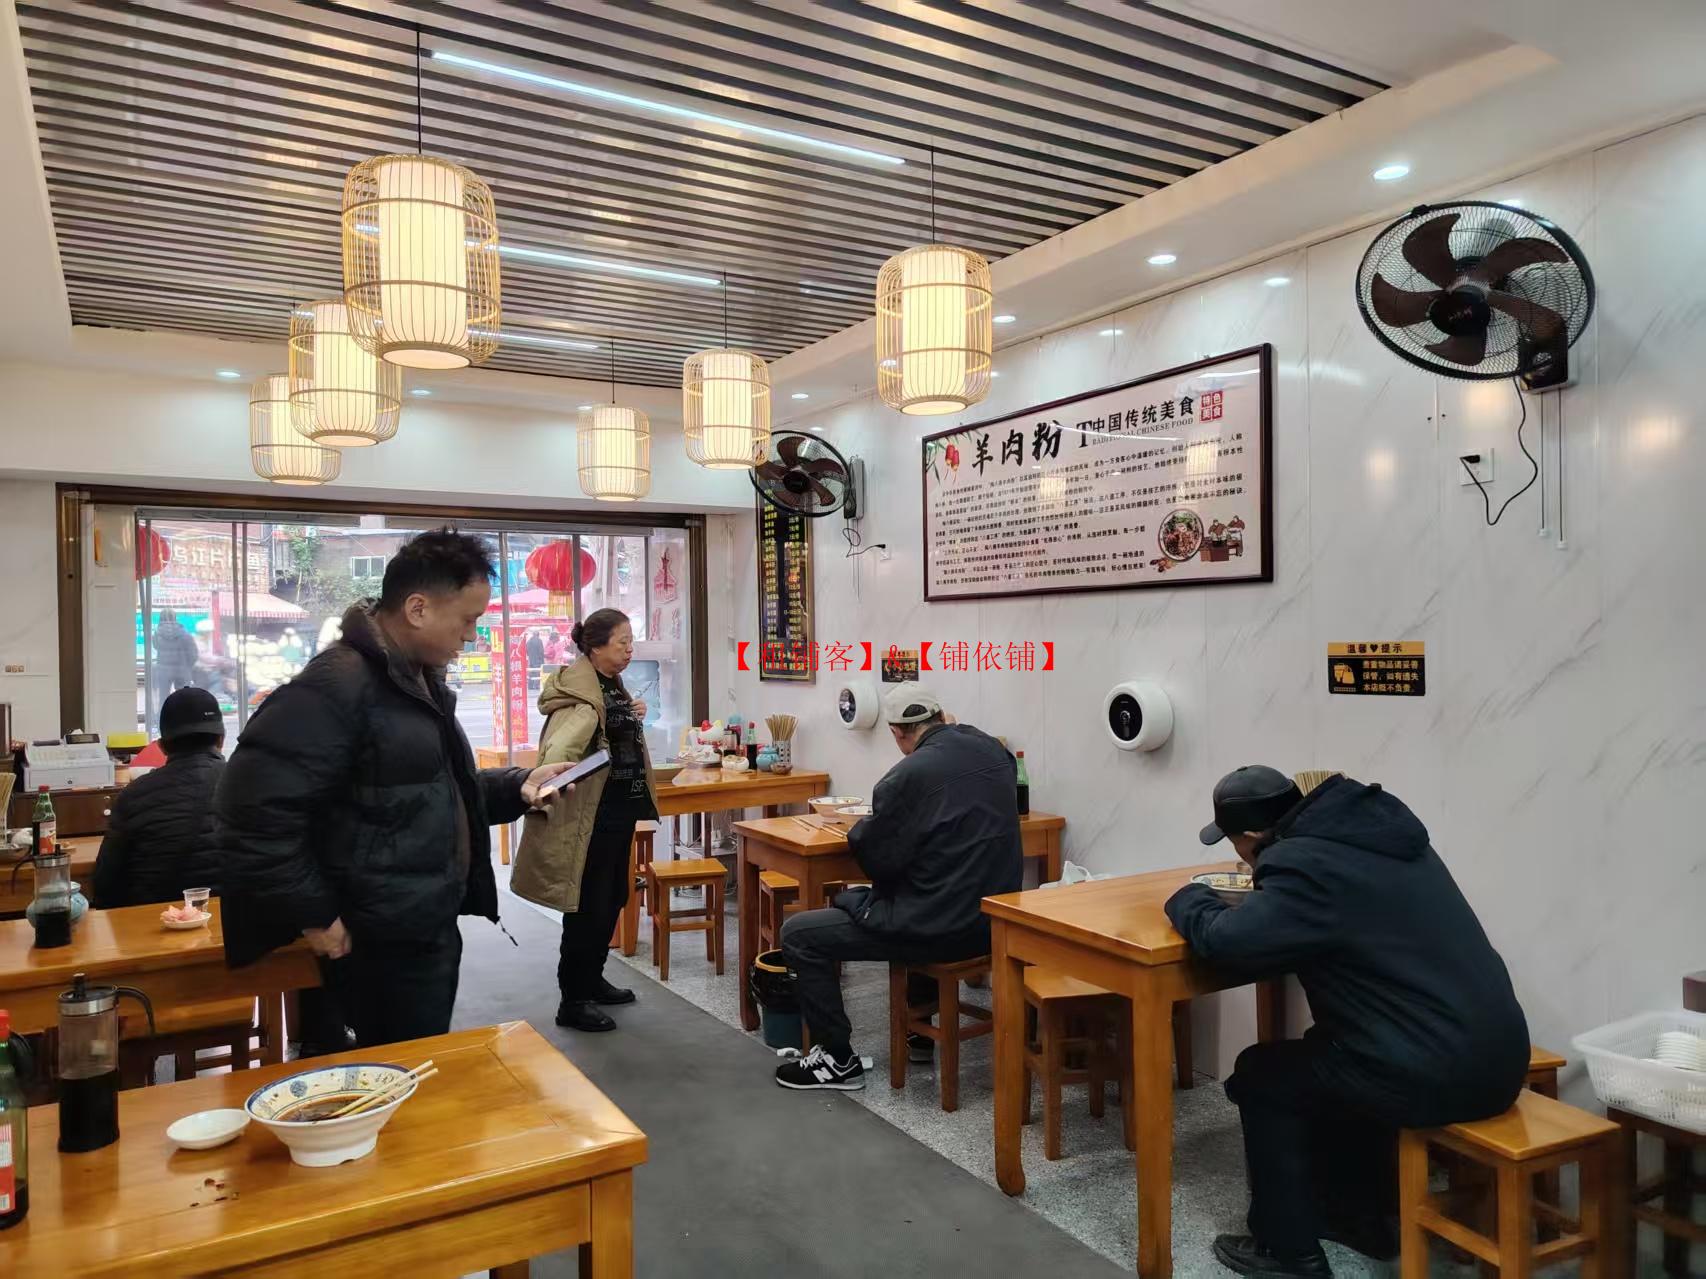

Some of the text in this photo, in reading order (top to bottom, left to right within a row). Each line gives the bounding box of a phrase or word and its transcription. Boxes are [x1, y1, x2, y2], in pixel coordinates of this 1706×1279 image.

[1092, 396, 1194, 433] 中国传统美食
[1136, 422, 1171, 435] CHINESE
[1171, 417, 1194, 429] FOOD
[972, 419, 1063, 477] 羊肉粉
